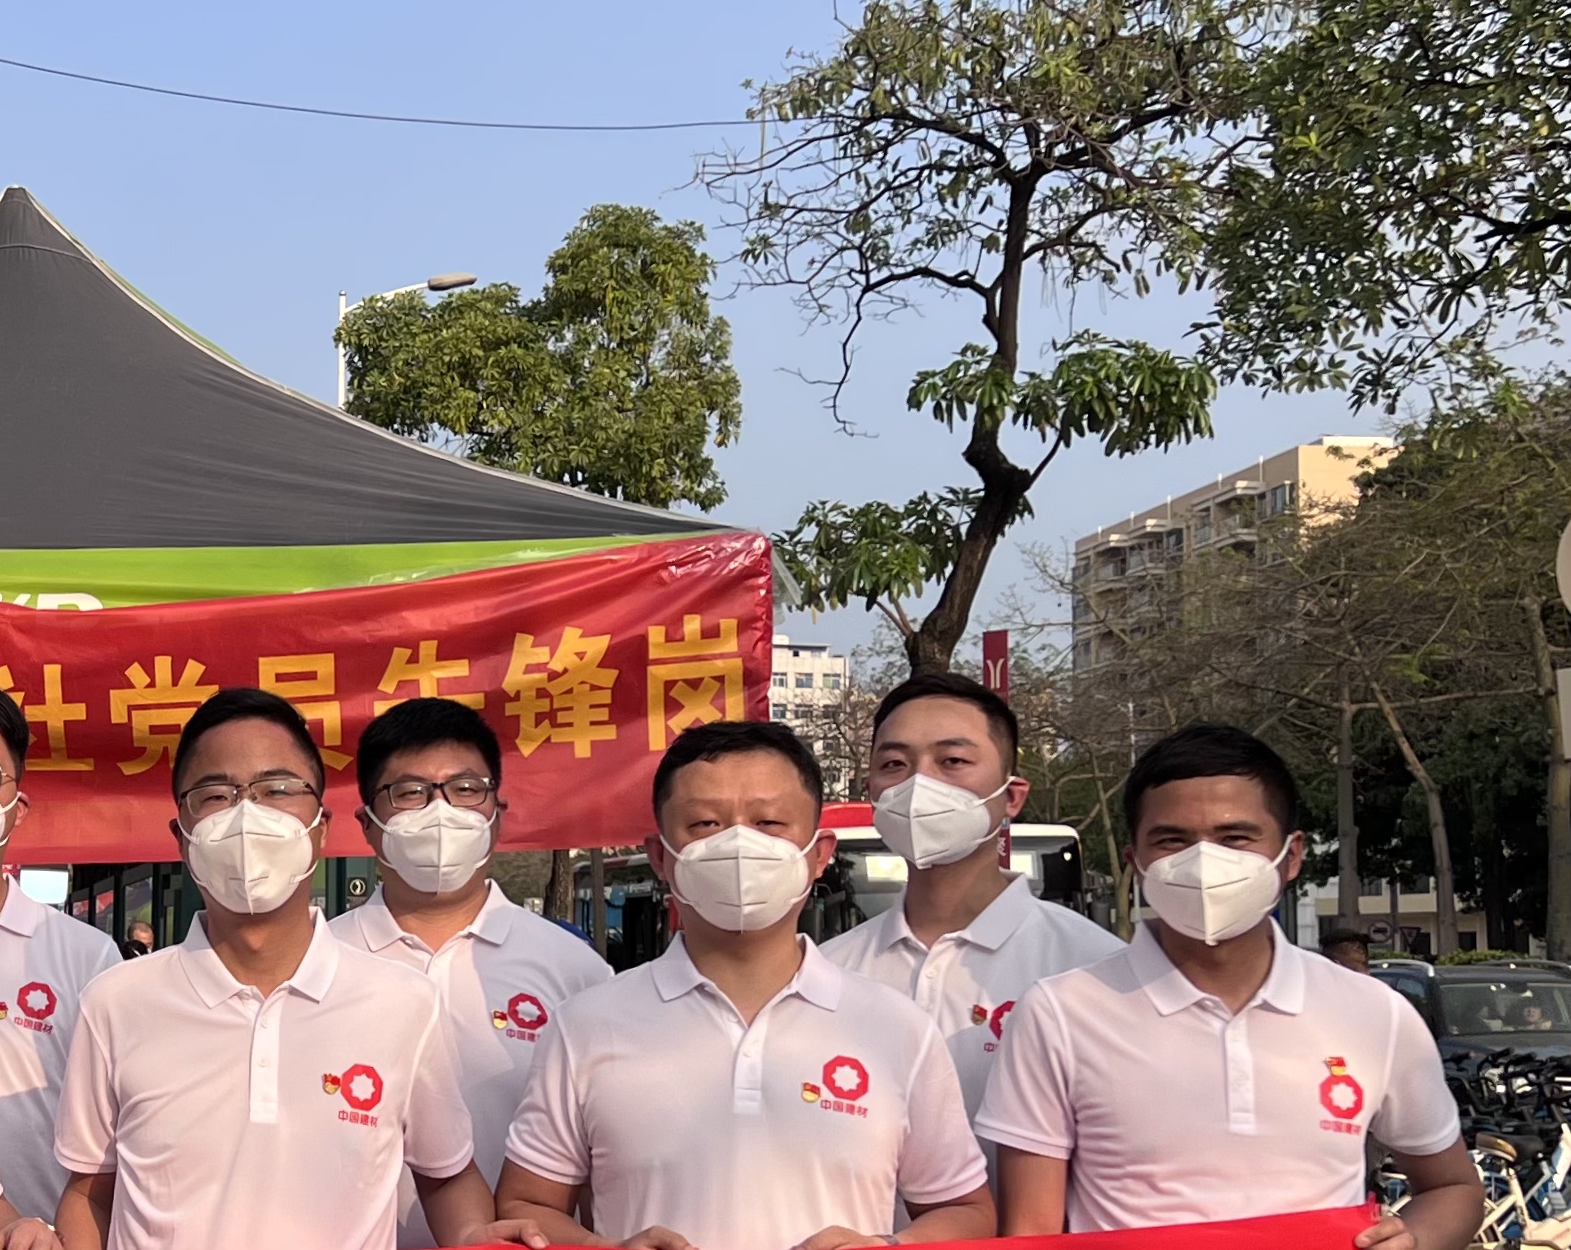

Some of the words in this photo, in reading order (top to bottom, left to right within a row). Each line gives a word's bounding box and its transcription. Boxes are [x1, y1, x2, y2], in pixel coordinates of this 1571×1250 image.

[14, 1017, 54, 1035] 中国建材
[506, 1028, 541, 1043] 中国建
[820, 1099, 868, 1118] 中国建材
[337, 1110, 379, 1128] 中国建材
